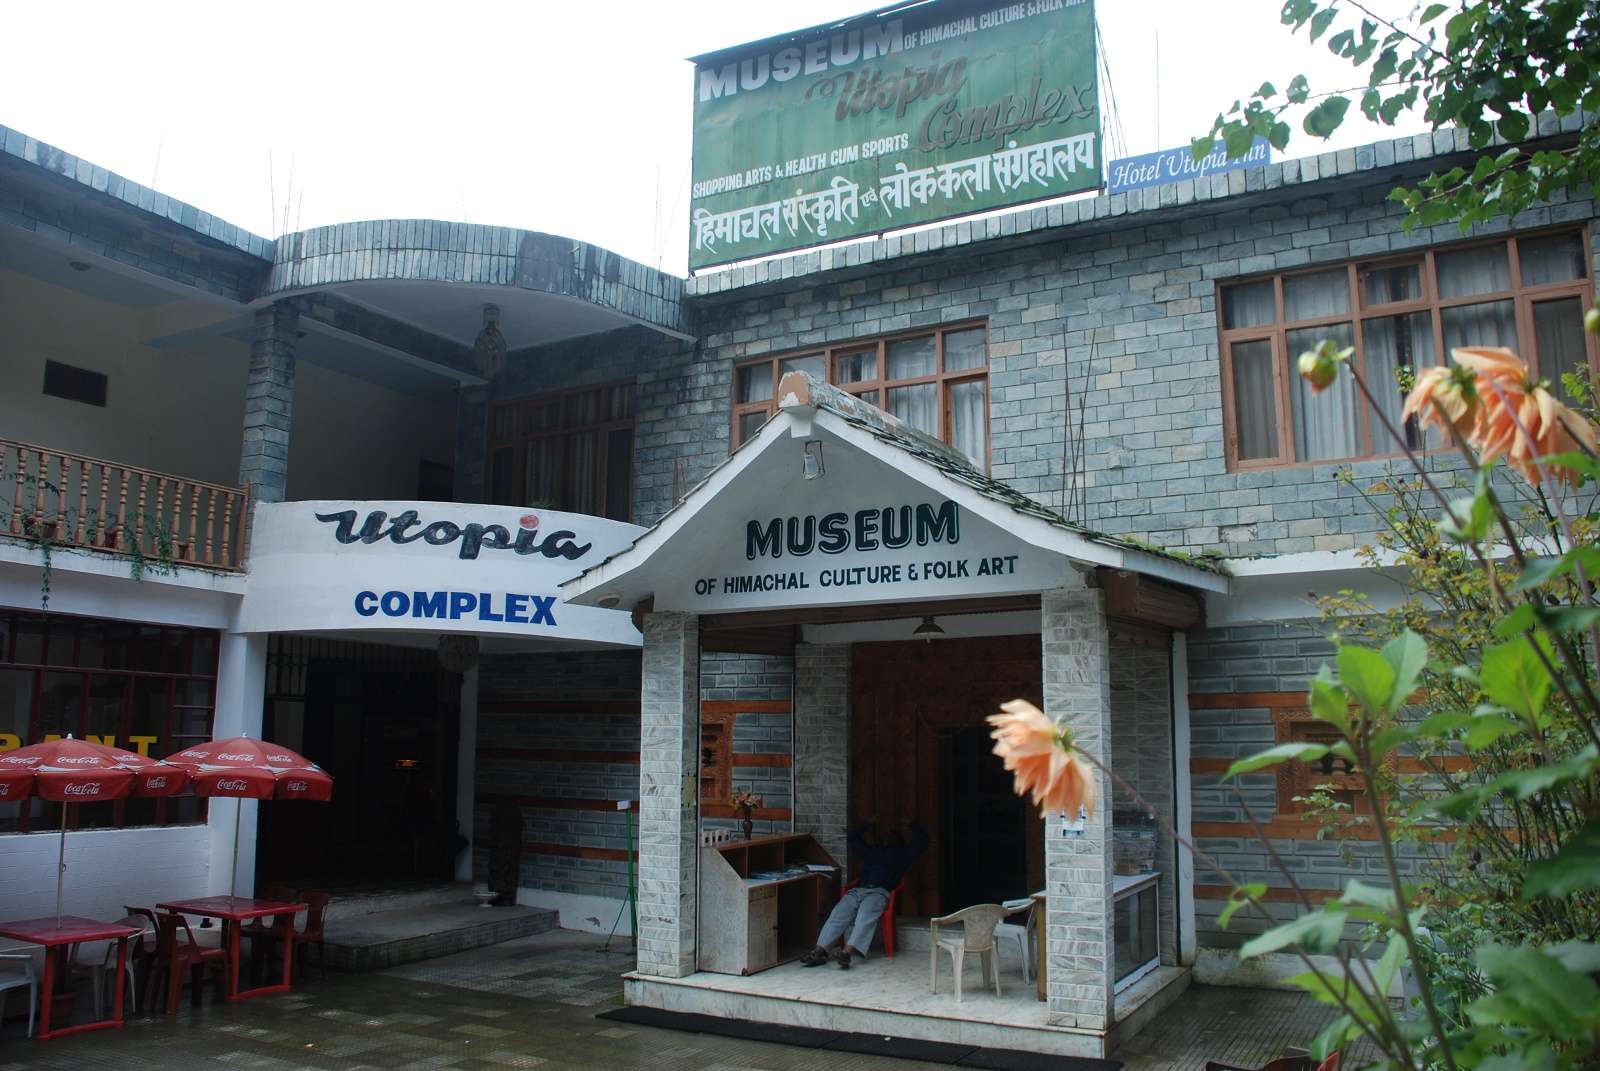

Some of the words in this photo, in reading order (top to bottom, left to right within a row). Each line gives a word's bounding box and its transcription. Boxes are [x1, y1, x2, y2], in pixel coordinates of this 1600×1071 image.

[700, 19, 903, 102] MUSEUM
[904, 32, 918, 50] OF
[919, 16, 977, 46] HIMACHAL
[980, 2, 1026, 29] CULTURE
[914, 77, 1094, 152] Complex
[744, 166, 772, 187] ARTS
[775, 164, 783, 178] &
[785, 153, 826, 177] HEALTH
[830, 145, 859, 165] CUM
[862, 133, 909, 158] SPORTS
[1112, 154, 1165, 189] Hotel
[692, 201, 782, 254] हिमाचल
[782, 175, 859, 237] संस्कृति
[315, 509, 592, 560] Utopia
[746, 500, 960, 561] MUSEUM
[694, 578, 717, 596] OF
[723, 571, 809, 594] HIMACHAL
[819, 564, 901, 587] CULTURE
[907, 563, 918, 581] &
[923, 559, 969, 580] FOLK
[976, 555, 1019, 576] ART
[354, 590, 558, 627] COMPLEX
